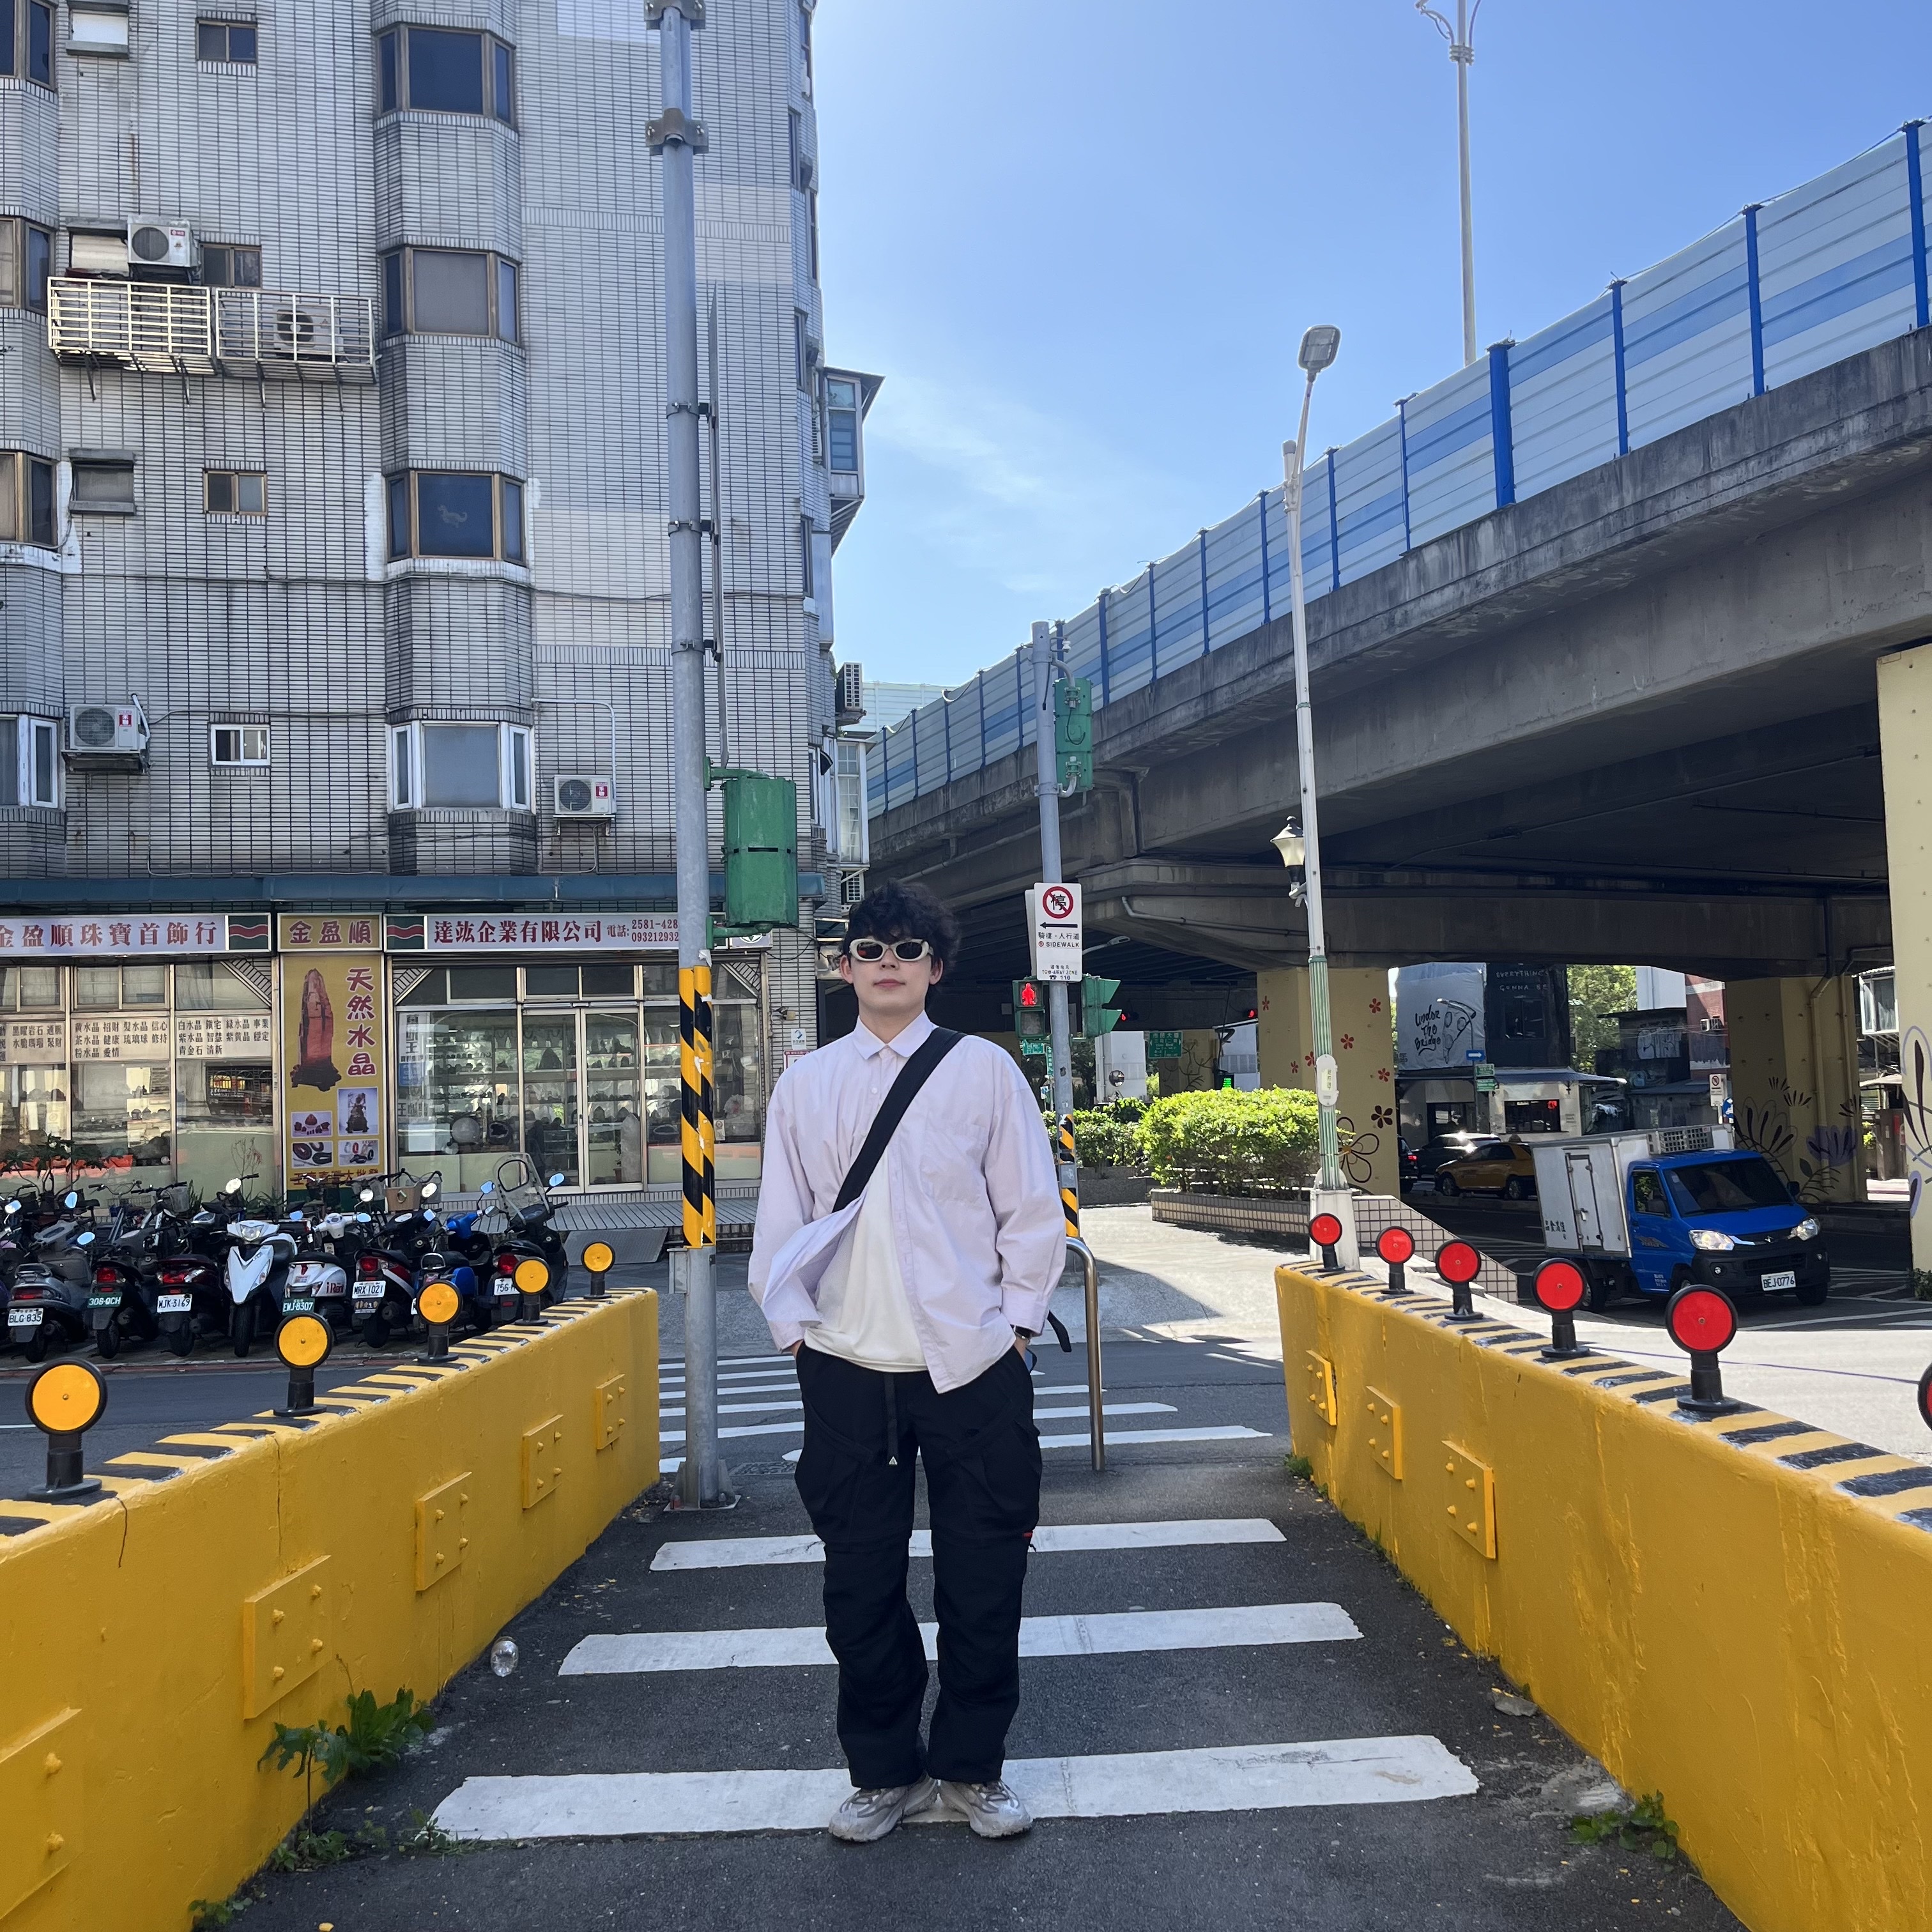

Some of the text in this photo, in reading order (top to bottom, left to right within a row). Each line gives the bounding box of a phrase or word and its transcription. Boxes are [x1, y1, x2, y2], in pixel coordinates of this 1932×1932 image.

[631, 919, 678, 929] 2581-428
[0, 921, 217, 947] 金盈順珠寶首飾行
[288, 919, 372, 944] 金盈順
[434, 920, 601, 943] 達竑企業有限公司
[631, 931, 679, 942] 093212932
[103, 1022, 119, 1032] 招財
[152, 1021, 168, 1031] 信心
[179, 1020, 202, 1031] 白水晶
[253, 1018, 269, 1029] 事業
[346, 967, 376, 1076] 天然水晶
[75, 1035, 100, 1045] 茶水晶
[103, 1034, 119, 1045] 健康
[179, 1032, 203, 1043] 紫水晶
[206, 1032, 223, 1043] 智慧
[253, 1031, 269, 1041] 穩定
[75, 1048, 119, 1059] 粉水晶 愛情
[206, 1045, 223, 1055] 清新
[1763, 1275, 1795, 1289] BEJ-0776
[353, 1285, 383, 1294] MRX-1021
[158, 1298, 190, 1308] MJK-3169
